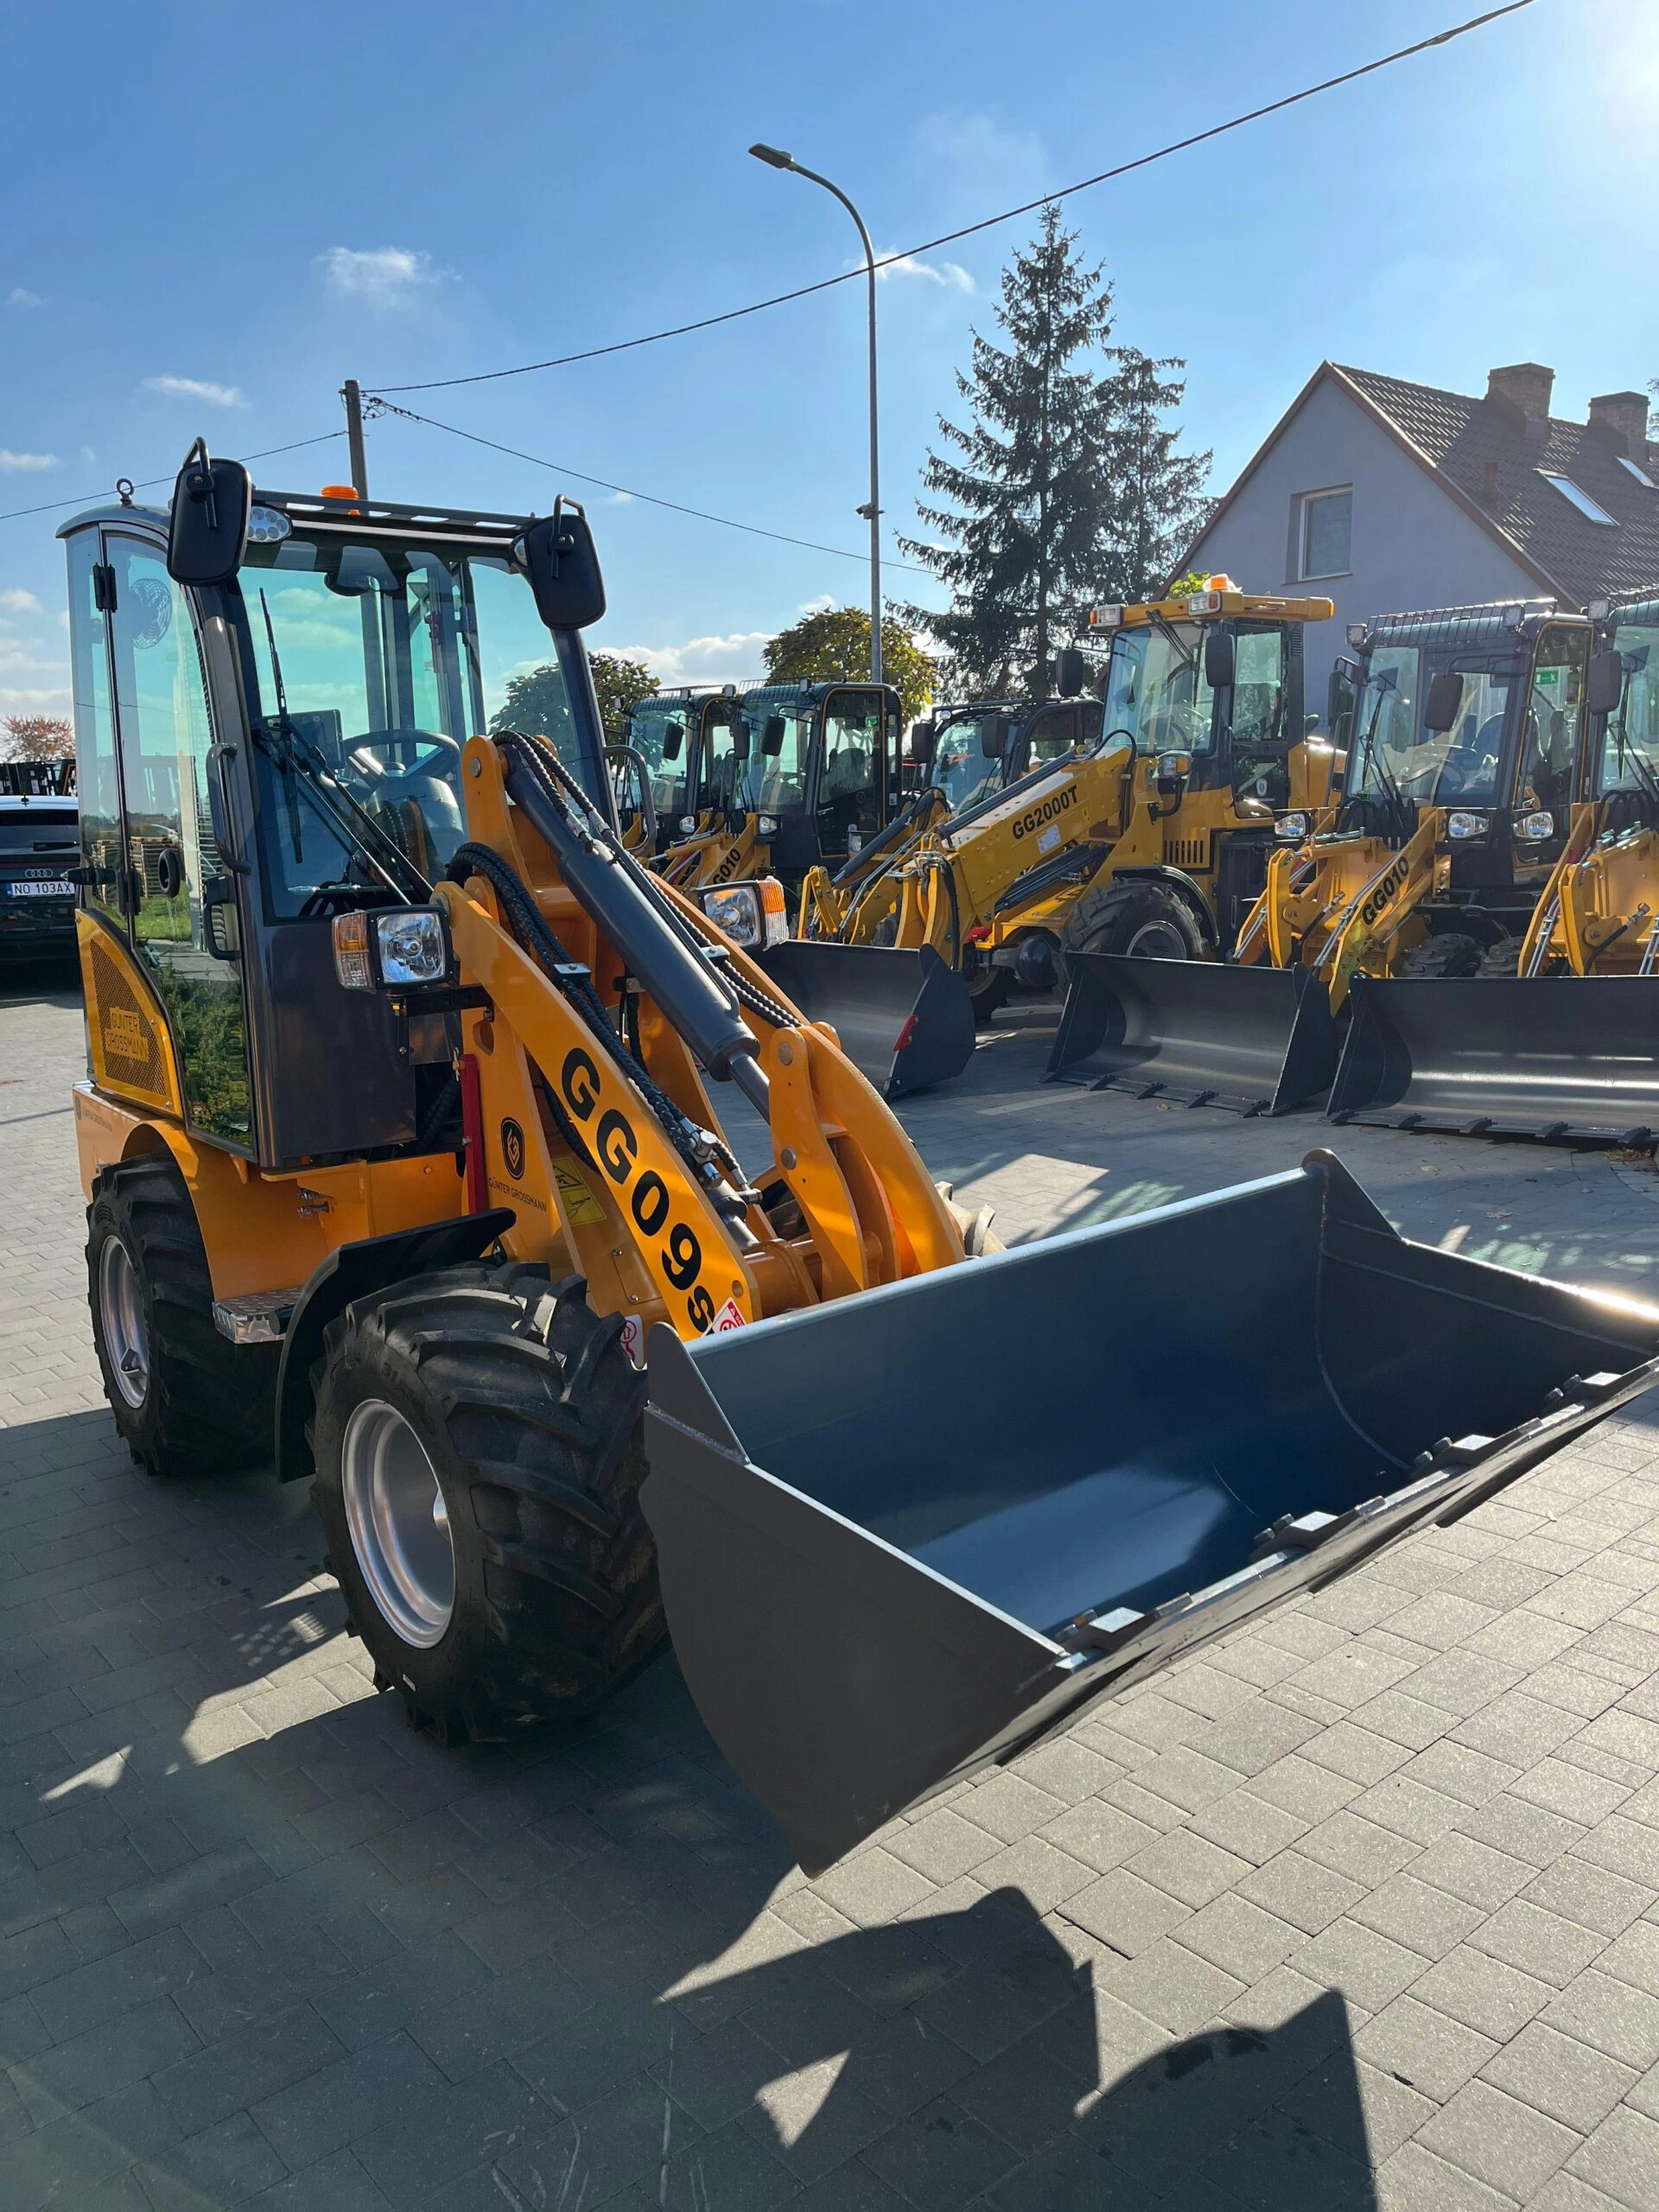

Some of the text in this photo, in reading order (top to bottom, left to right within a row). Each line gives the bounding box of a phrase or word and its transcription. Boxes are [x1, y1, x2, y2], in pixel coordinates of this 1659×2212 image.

[1012, 785, 1077, 839] GG2000T
[15, 884, 30, 894] NO
[35, 882, 71, 893] 103AX
[1362, 856, 1409, 925] GG010
[488, 1177, 546, 1213] GÜNTER GROSSMANN
